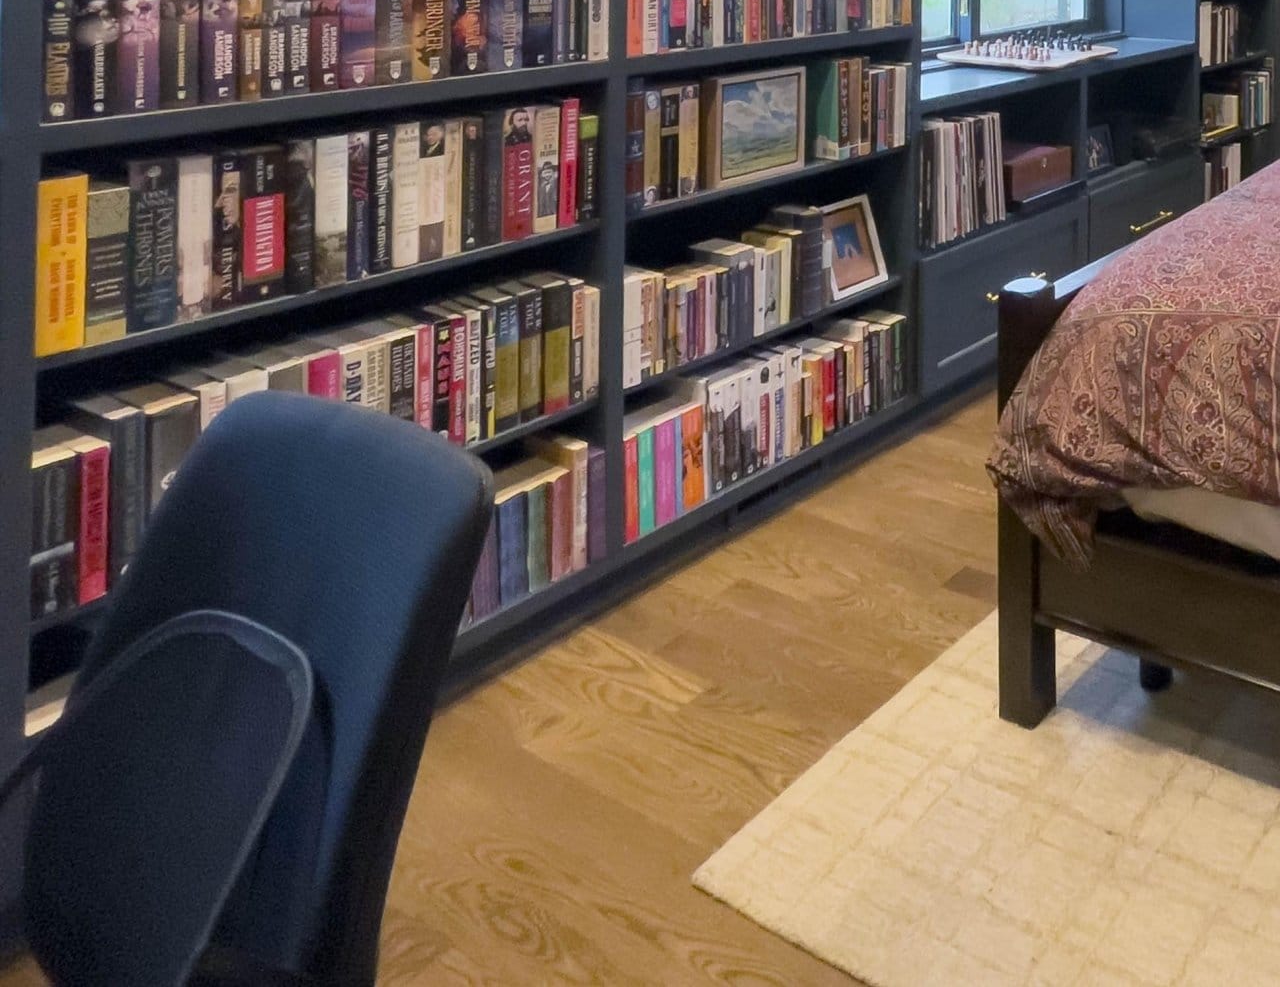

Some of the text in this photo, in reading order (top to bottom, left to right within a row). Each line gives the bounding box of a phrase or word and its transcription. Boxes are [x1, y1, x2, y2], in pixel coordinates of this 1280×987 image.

[290, 23, 301, 72] SANDERSON
[299, 27, 309, 68] BRANDON
[321, 22, 332, 70] SANDERSON
[330, 26, 339, 65] BRANDON
[647, 13, 657, 33] DIRT
[47, 42, 71, 96] ELANTRIS
[94, 42, 104, 101] WARBREAKER
[214, 29, 225, 80] SANDERSON
[223, 33, 234, 75] BRANDON
[267, 28, 279, 78] SANDERSON
[276, 31, 286, 72] BRANDON
[376, 156, 390, 192] BRANDS
[518, 149, 531, 214] GRANT
[136, 212, 153, 287] THRONES
[155, 207, 175, 277] POWERS
[255, 198, 274, 272] WASHINGTON
[222, 247, 233, 301] HENRY V
[499, 311, 510, 339] TOLL
[524, 302, 535, 329] TOLL
[391, 345, 403, 394] RHODES
[403, 342, 415, 389] RICHARD
[453, 325, 466, 382] BOHEMIANS
